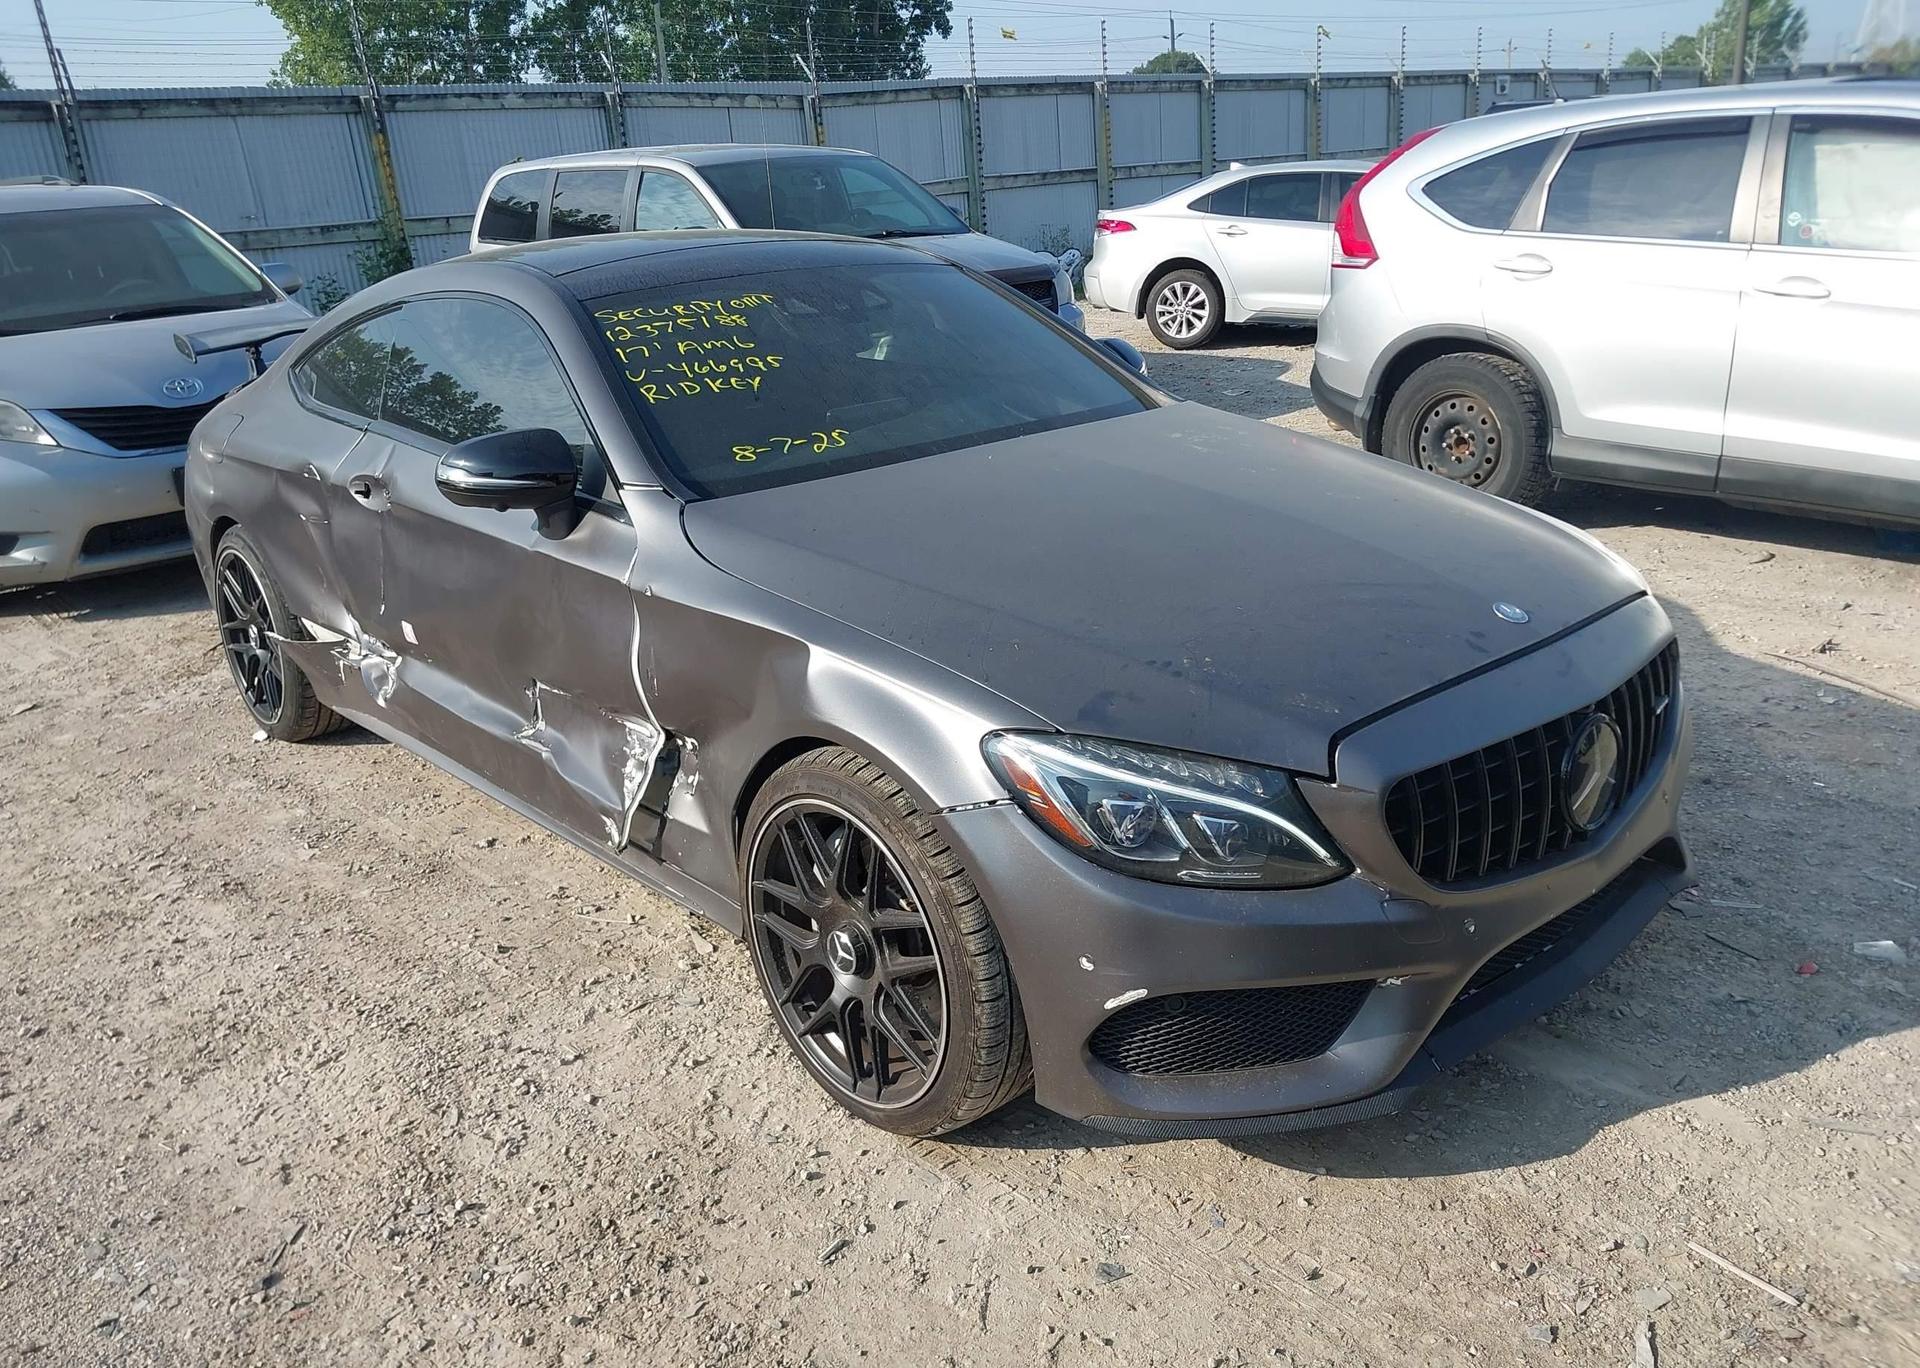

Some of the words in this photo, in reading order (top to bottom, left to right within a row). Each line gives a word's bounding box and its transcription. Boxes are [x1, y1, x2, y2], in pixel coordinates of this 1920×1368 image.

[594, 300, 729, 323] SECURITY
[605, 314, 748, 342] 12375188
[732, 428, 849, 462] 8-7-25
